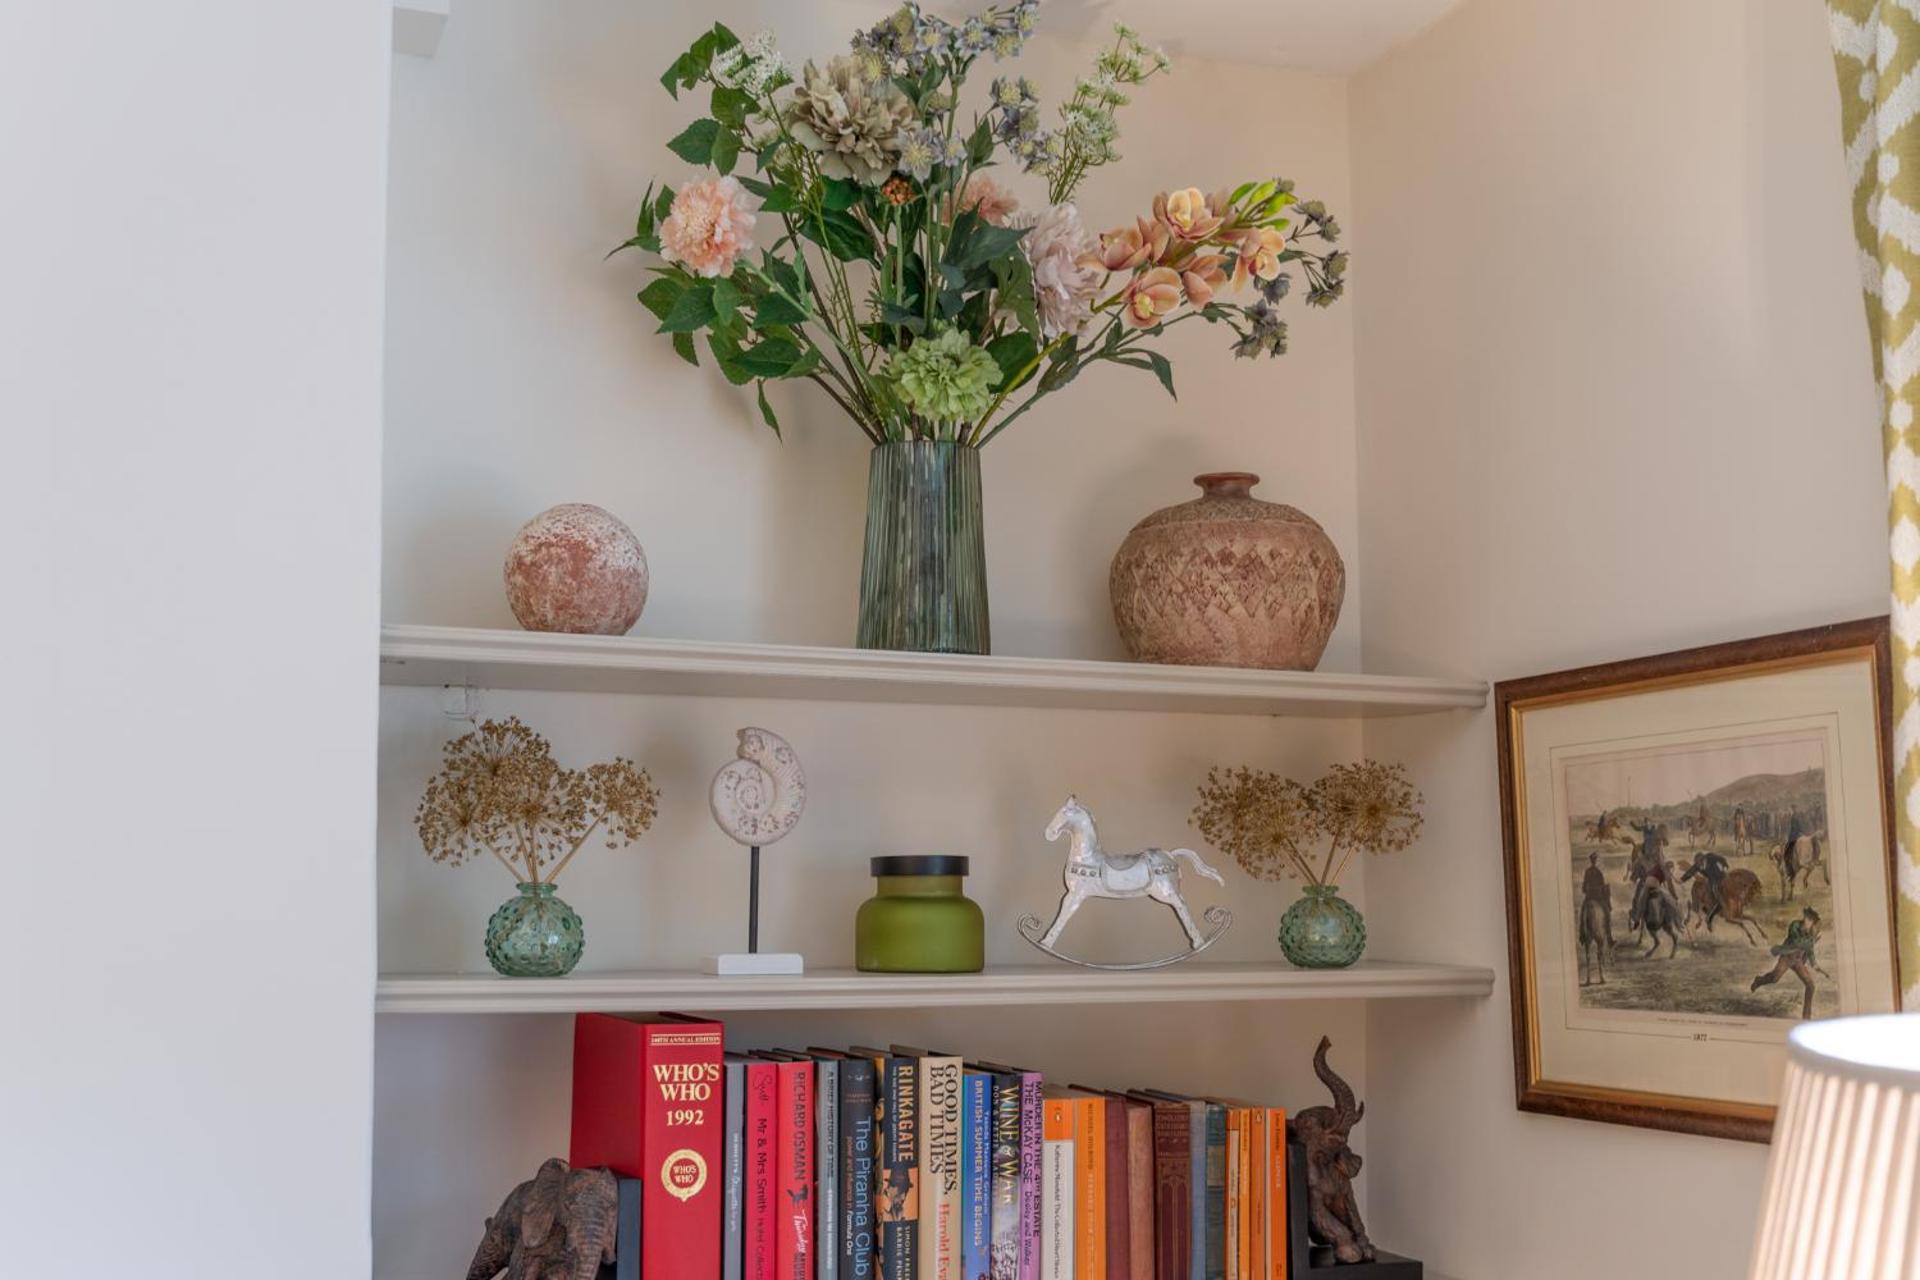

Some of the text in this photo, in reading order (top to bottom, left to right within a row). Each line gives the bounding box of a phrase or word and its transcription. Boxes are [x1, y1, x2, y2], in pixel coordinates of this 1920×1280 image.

[653, 1063, 720, 1082] WHO'S
[660, 1083, 711, 1101] WHO
[1024, 1082, 1034, 1105] THE
[1034, 1081, 1043, 1129] MURDER
[666, 1109, 704, 1126] 1992
[757, 1118, 767, 1133] Mr
[793, 1071, 806, 1181] RICHARD OSMAN
[898, 1065, 913, 1162] RINKAGATE
[930, 1065, 944, 1174] BAD TIMES
[943, 1064, 958, 1195] GOOD TIMES,
[999, 1084, 1020, 1143] WINE
[1024, 1109, 1034, 1149] McKAY
[757, 1138, 767, 1148] &
[856, 1115, 871, 1151] The
[1034, 1132, 1042, 1145] IN
[757, 1152, 768, 1174] Mrs
[974, 1079, 983, 1246] BRITISH SUMMER TIME BEGINS
[1023, 1153, 1033, 1184] CASE
[1034, 1149, 1042, 1169] THE
[674, 1174, 694, 1183] WHO
[757, 1178, 768, 1212] Smith
[856, 1157, 871, 1226] Piranha
[1000, 1158, 1019, 1205] WAR
[938, 1203, 950, 1251] Harold
[1033, 1195, 1041, 1237] ESTATE
[856, 1231, 870, 1276] Club
